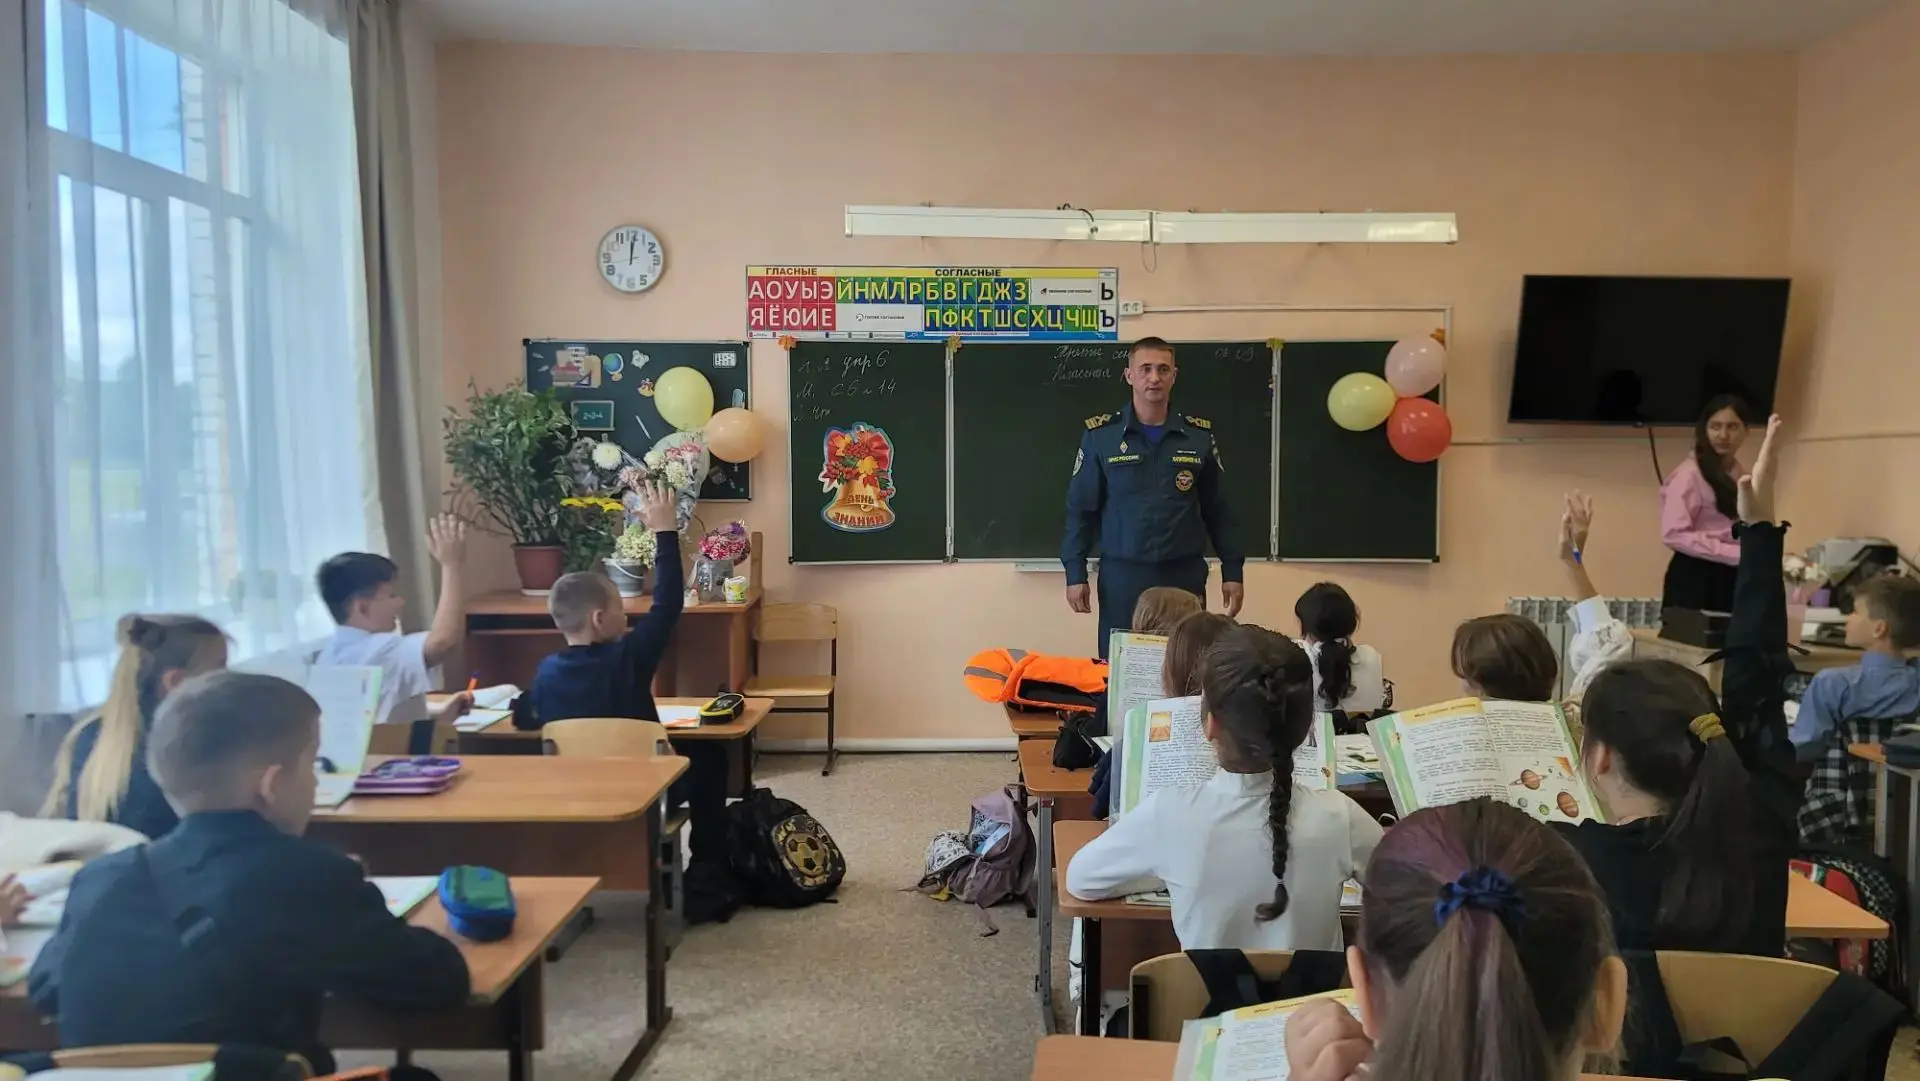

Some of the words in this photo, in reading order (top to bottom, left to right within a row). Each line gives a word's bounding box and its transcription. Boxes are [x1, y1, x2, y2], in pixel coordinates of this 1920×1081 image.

[616, 232, 624, 244] 11
[626, 229, 639, 242] 12
[607, 241, 620, 252] 10
[647, 241, 656, 254] 2
[602, 252, 611, 264] 9
[653, 254, 661, 266] 3
[606, 264, 615, 276] 8
[765, 267, 818, 276] ГЛАСНЫЕ
[935, 268, 1002, 277] СОГЛАСНЫЕ
[616, 272, 624, 286] 7
[626, 276, 635, 289] 6
[640, 274, 647, 286] 5
[1101, 282, 1114, 301] Ь
[1099, 309, 1116, 328] Ъ
[876, 349, 890, 368] 6
[847, 494, 875, 505] ДЕНЬ
[834, 511, 885, 526] ЗНАНИЙ
